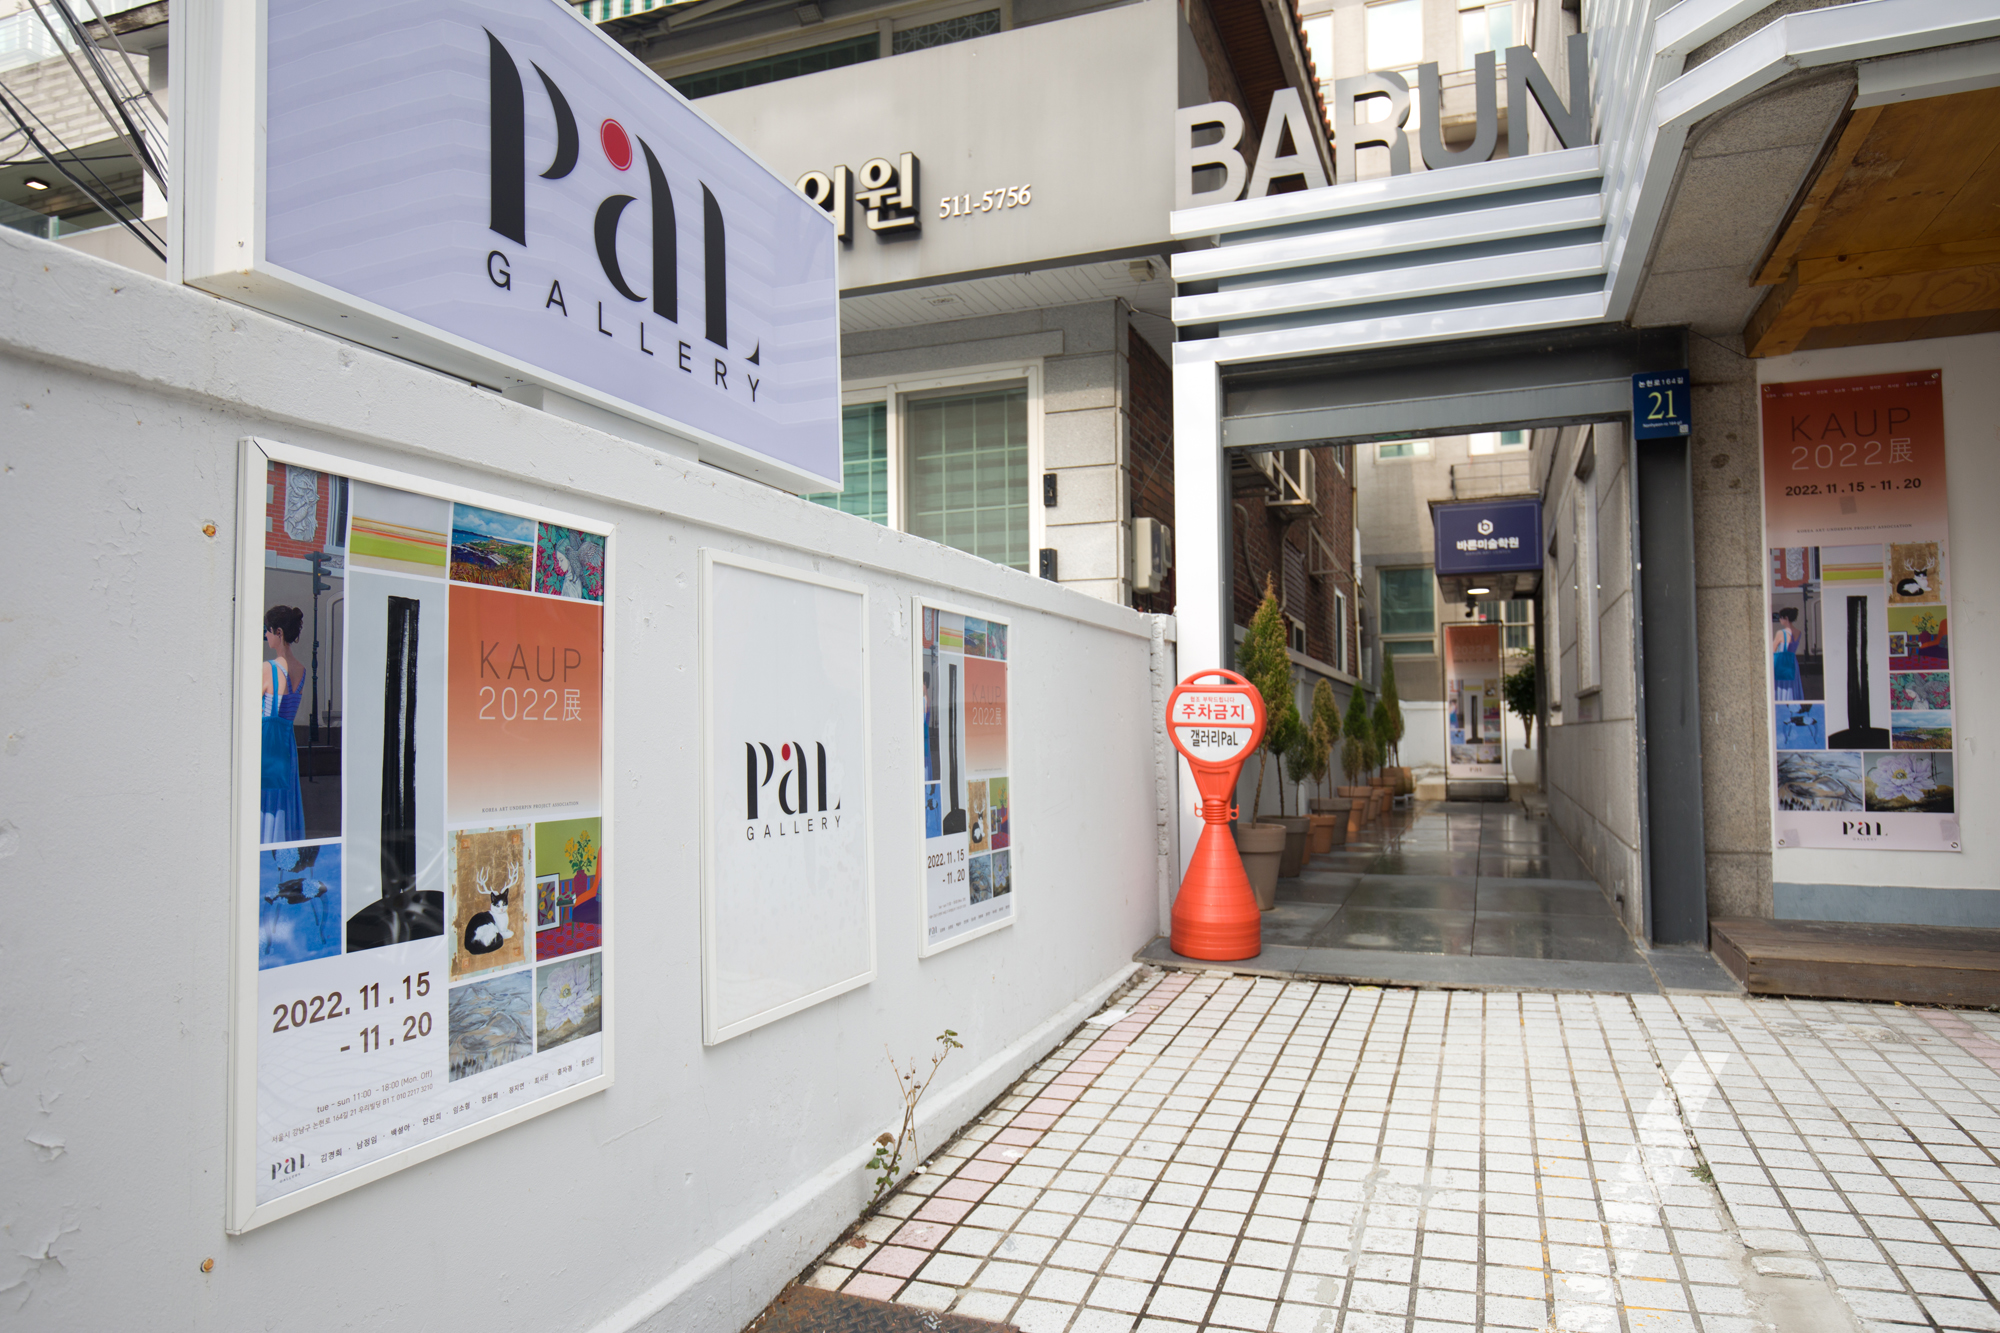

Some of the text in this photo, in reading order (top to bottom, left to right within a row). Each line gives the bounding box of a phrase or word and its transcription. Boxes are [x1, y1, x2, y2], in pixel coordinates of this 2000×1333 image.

[1174, 32, 1592, 211] BARUN
[939, 184, 1031, 219] 511-5756
[487, 250, 759, 402] GALLERY
[1647, 390, 1677, 419] 21
[1791, 407, 1911, 442] KAUP
[480, 640, 581, 683] KAUP
[972, 684, 1001, 705] KAUP
[1182, 704, 1244, 720] 주차금지
[747, 815, 840, 841] GALLERY
[317, 1104, 329, 1113] tue
[337, 1097, 350, 1107] sun
[353, 1089, 371, 1101] 11:00
[382, 1080, 399, 1092] 18:00
[421, 1070, 432, 1079] Off)
[272, 1131, 290, 1143] 서울시
[293, 1124, 311, 1137] 강남구
[350, 1109, 356, 1117] 21
[396, 1092, 406, 1101] 010
[407, 1088, 419, 1097] 2217
[421, 1083, 433, 1093] 3210
